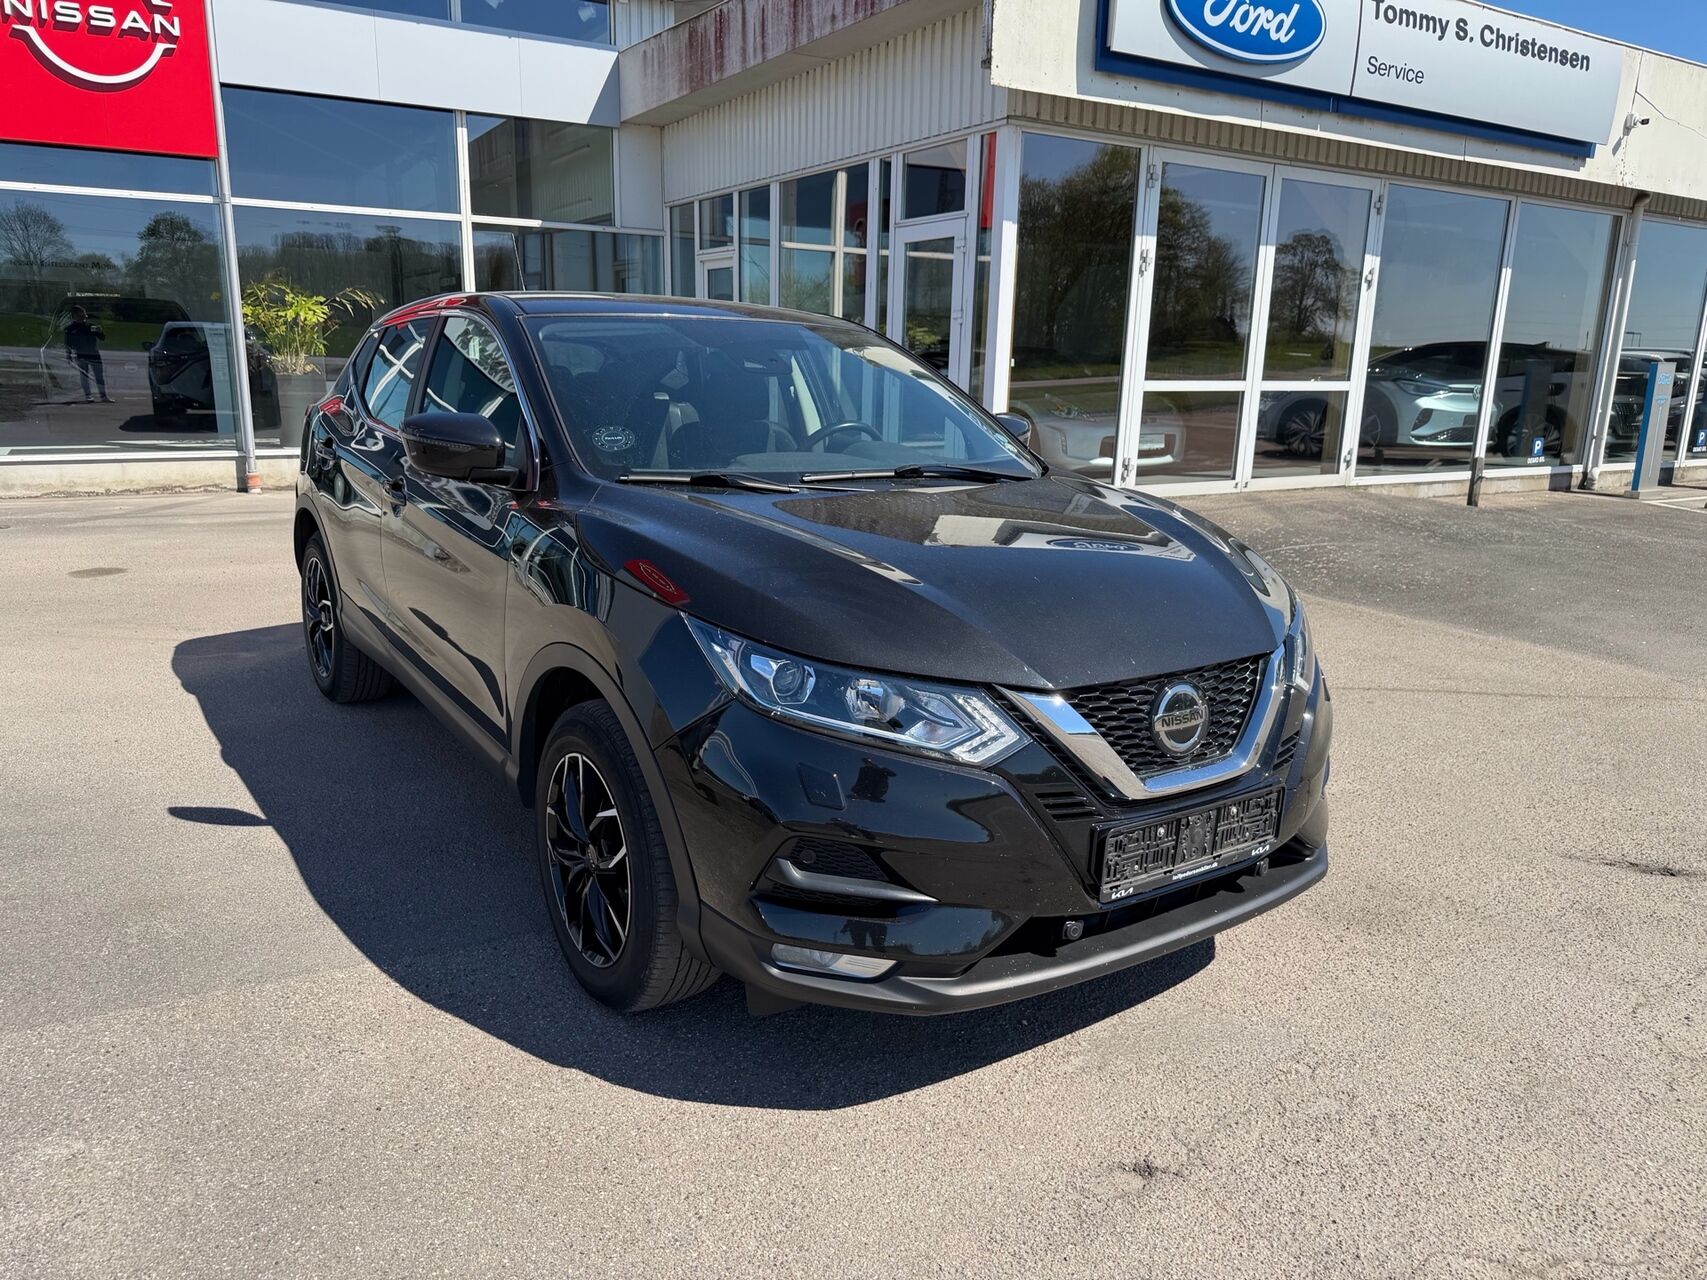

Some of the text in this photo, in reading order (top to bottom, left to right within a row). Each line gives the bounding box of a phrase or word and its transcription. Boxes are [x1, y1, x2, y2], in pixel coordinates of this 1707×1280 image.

[3, 0, 180, 37] NISSAN
[1371, 0, 1590, 72] Tommy S. Christensen
[1366, 55, 1425, 84] Service
[1161, 708, 1204, 728] NISSAN
